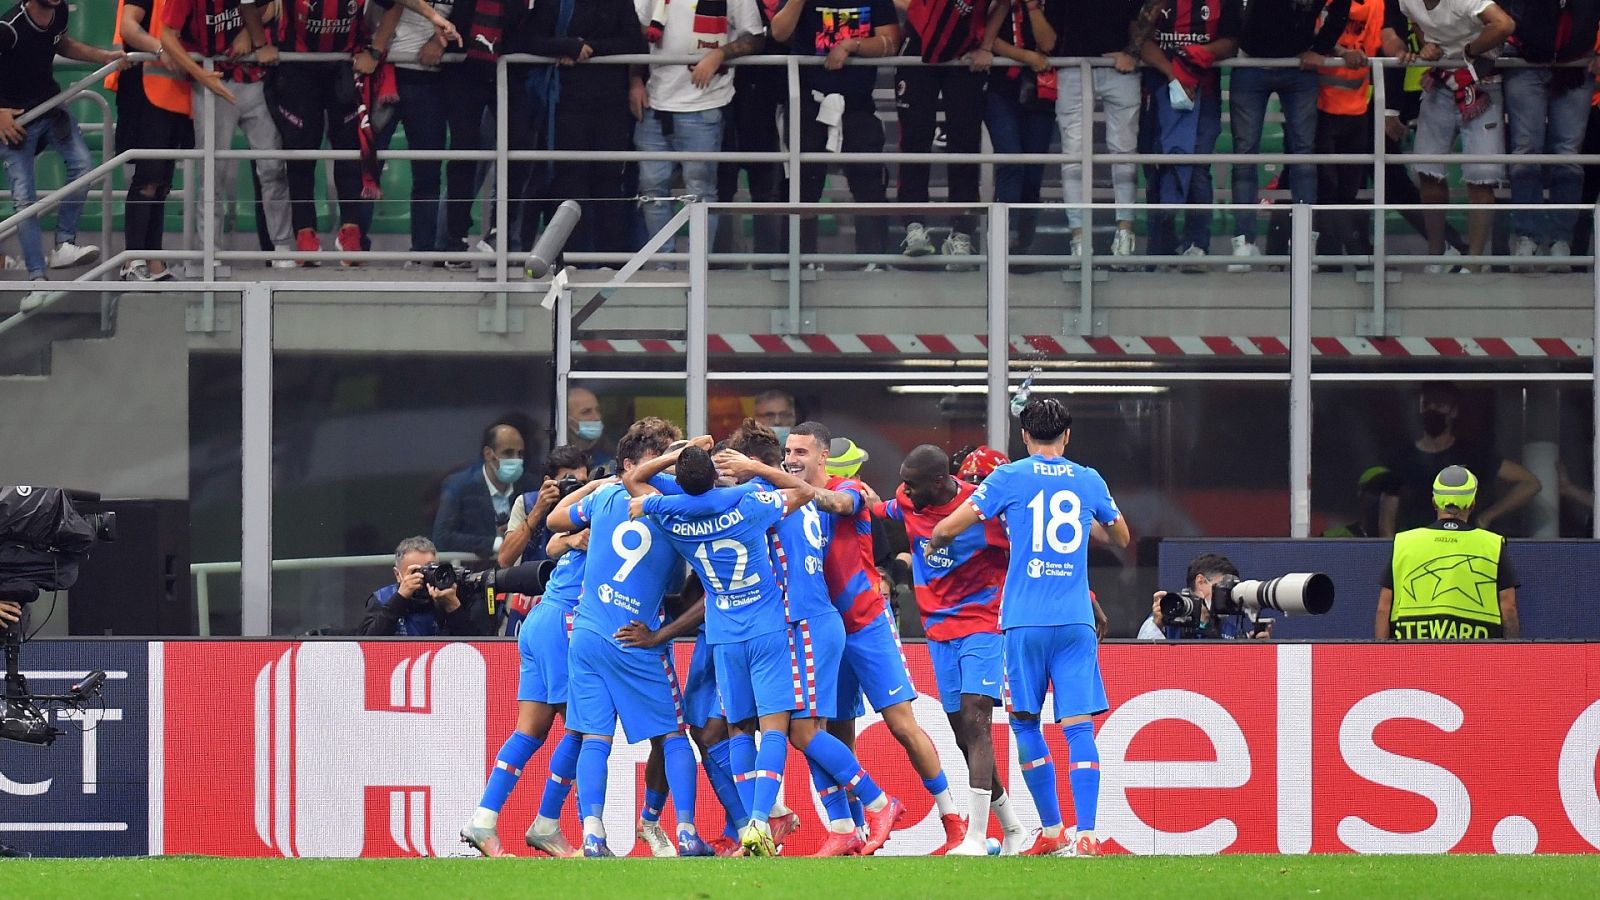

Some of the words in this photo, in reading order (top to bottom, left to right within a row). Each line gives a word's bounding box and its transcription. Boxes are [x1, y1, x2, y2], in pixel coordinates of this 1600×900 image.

[205, 8, 240, 25] Emira
[1033, 462, 1075, 477] FELIPE
[672, 519, 713, 536] RENAN
[714, 508, 744, 532] LODI
[800, 500, 823, 550] 8
[1026, 489, 1083, 554] 18
[611, 520, 653, 583] 9
[694, 538, 761, 593] 12
[1045, 561, 1063, 569] Save
[613, 599, 640, 615] Children
[614, 591, 630, 603] Save
[630, 598, 641, 607] the
[732, 594, 762, 607] Children
